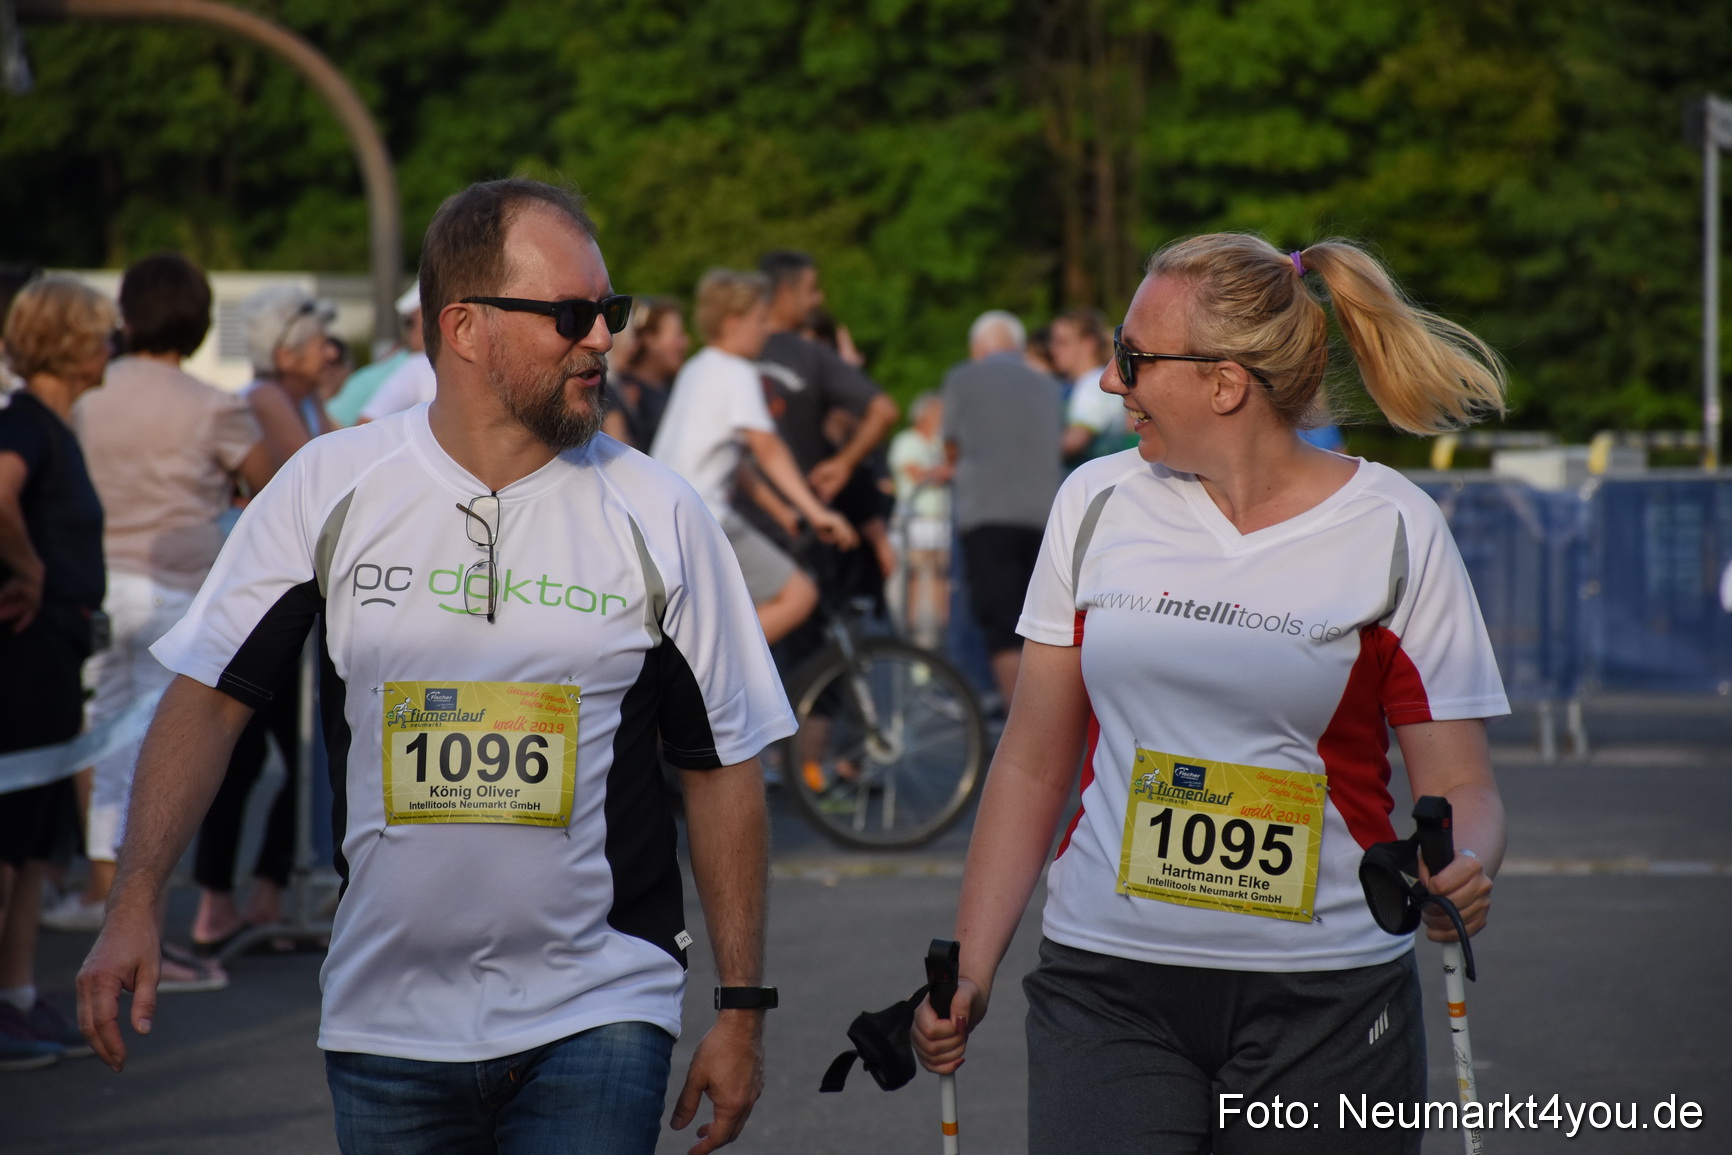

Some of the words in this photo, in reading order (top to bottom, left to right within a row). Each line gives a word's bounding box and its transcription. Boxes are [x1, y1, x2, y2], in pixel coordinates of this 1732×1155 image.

[353, 563, 413, 597] pc
[428, 562, 627, 616] doktor
[1093, 591, 1342, 643] www.intellitools.de
[410, 708, 486, 722] firmenlauf
[493, 715, 528, 732] walk
[530, 722, 566, 734] 2019
[405, 732, 549, 784] 1096
[1179, 769, 1201, 778] Fischer
[429, 785, 472, 800] König
[476, 785, 521, 798] Oliver
[1156, 781, 1235, 806] firmenlauf
[1156, 796, 1189, 806] neumarkt
[409, 800, 457, 811] Intellitools
[459, 800, 507, 810] Neumarkt
[510, 801, 541, 811] GmbH
[1239, 804, 1274, 821] walk
[1275, 810, 1311, 825] 2019
[1149, 807, 1295, 876] 1095
[1161, 862, 1234, 885] Hartmann
[1238, 873, 1271, 890] Elke
[1146, 875, 1197, 893] Intellitools
[1199, 884, 1249, 900] Neumarkt
[1250, 891, 1283, 905] GmbH
